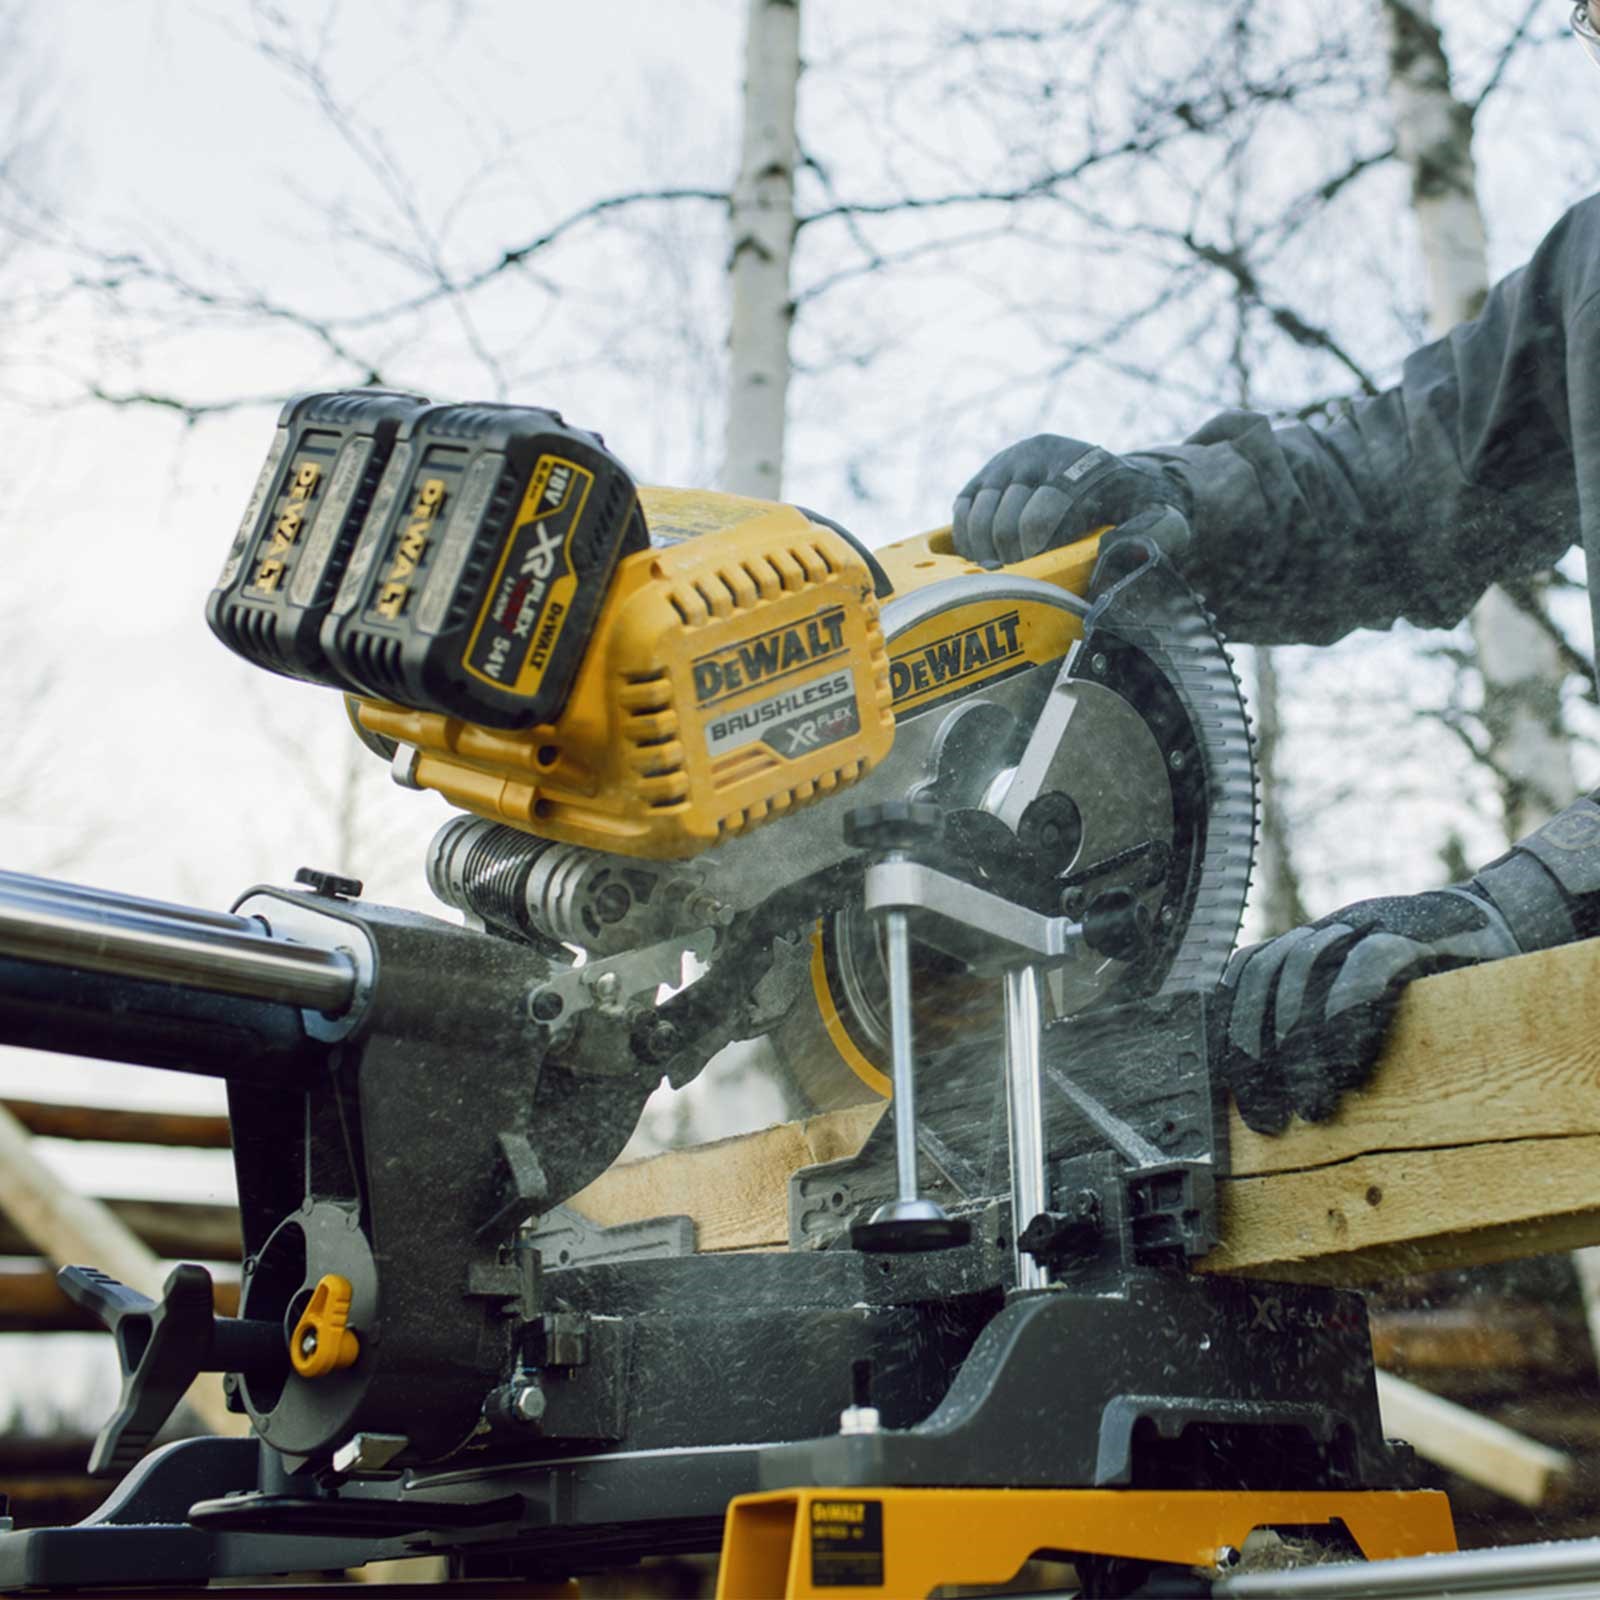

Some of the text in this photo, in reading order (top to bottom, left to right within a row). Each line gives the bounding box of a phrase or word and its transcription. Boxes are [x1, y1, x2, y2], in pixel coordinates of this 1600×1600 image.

[544, 466, 571, 507] 18V
[512, 520, 564, 638] XR FLEX
[483, 636, 511, 678] 54V
[711, 676, 850, 742] BRUSHLESS
[786, 720, 820, 753] XR
